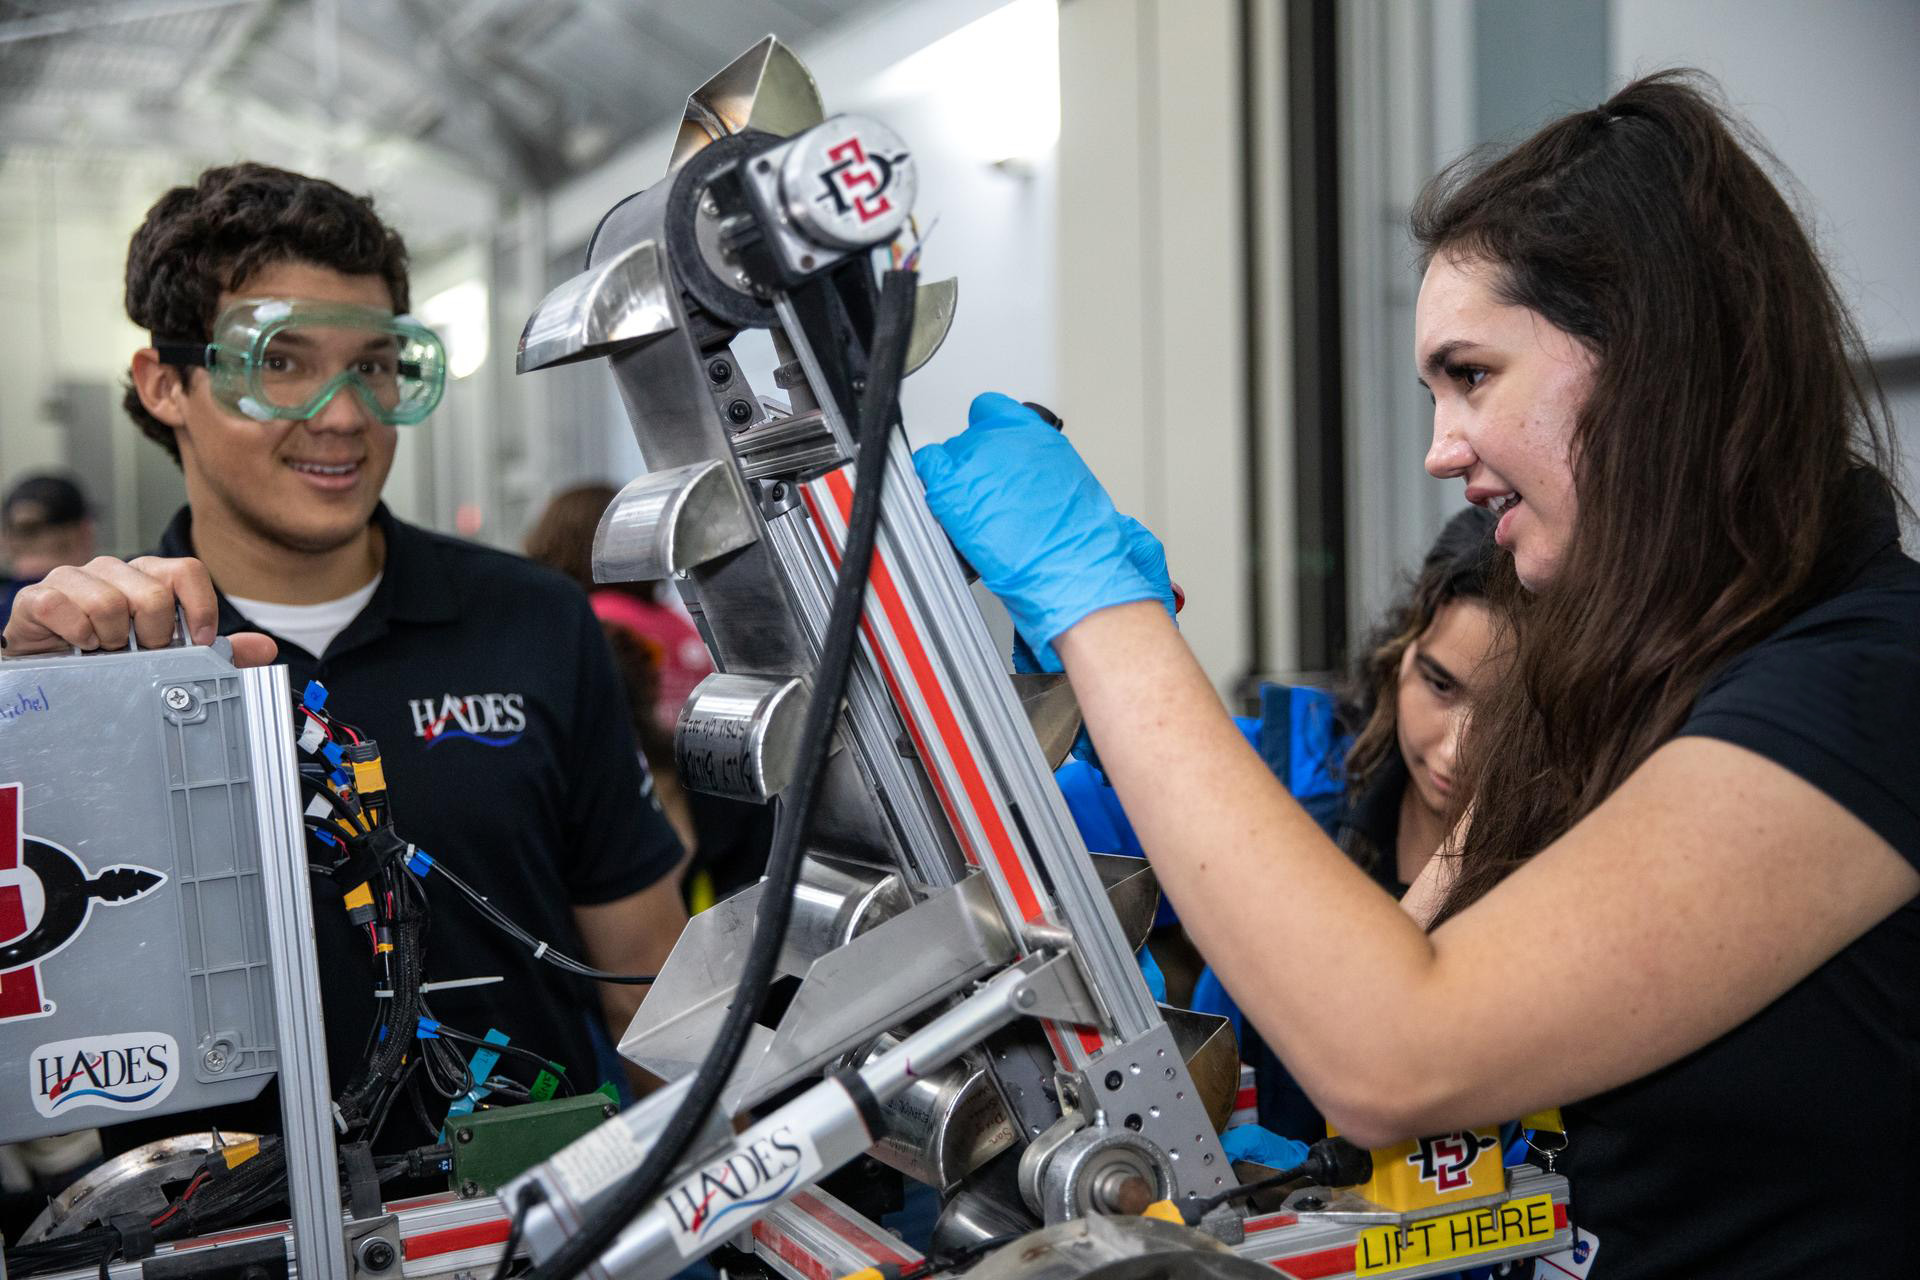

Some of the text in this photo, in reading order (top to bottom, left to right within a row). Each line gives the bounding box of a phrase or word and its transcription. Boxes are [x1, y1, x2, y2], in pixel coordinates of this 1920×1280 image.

[408, 693, 526, 738] HADES
[38, 1044, 168, 1100] HADES
[665, 1126, 802, 1232] HADES
[1362, 1201, 1550, 1269] LIFT HERE
